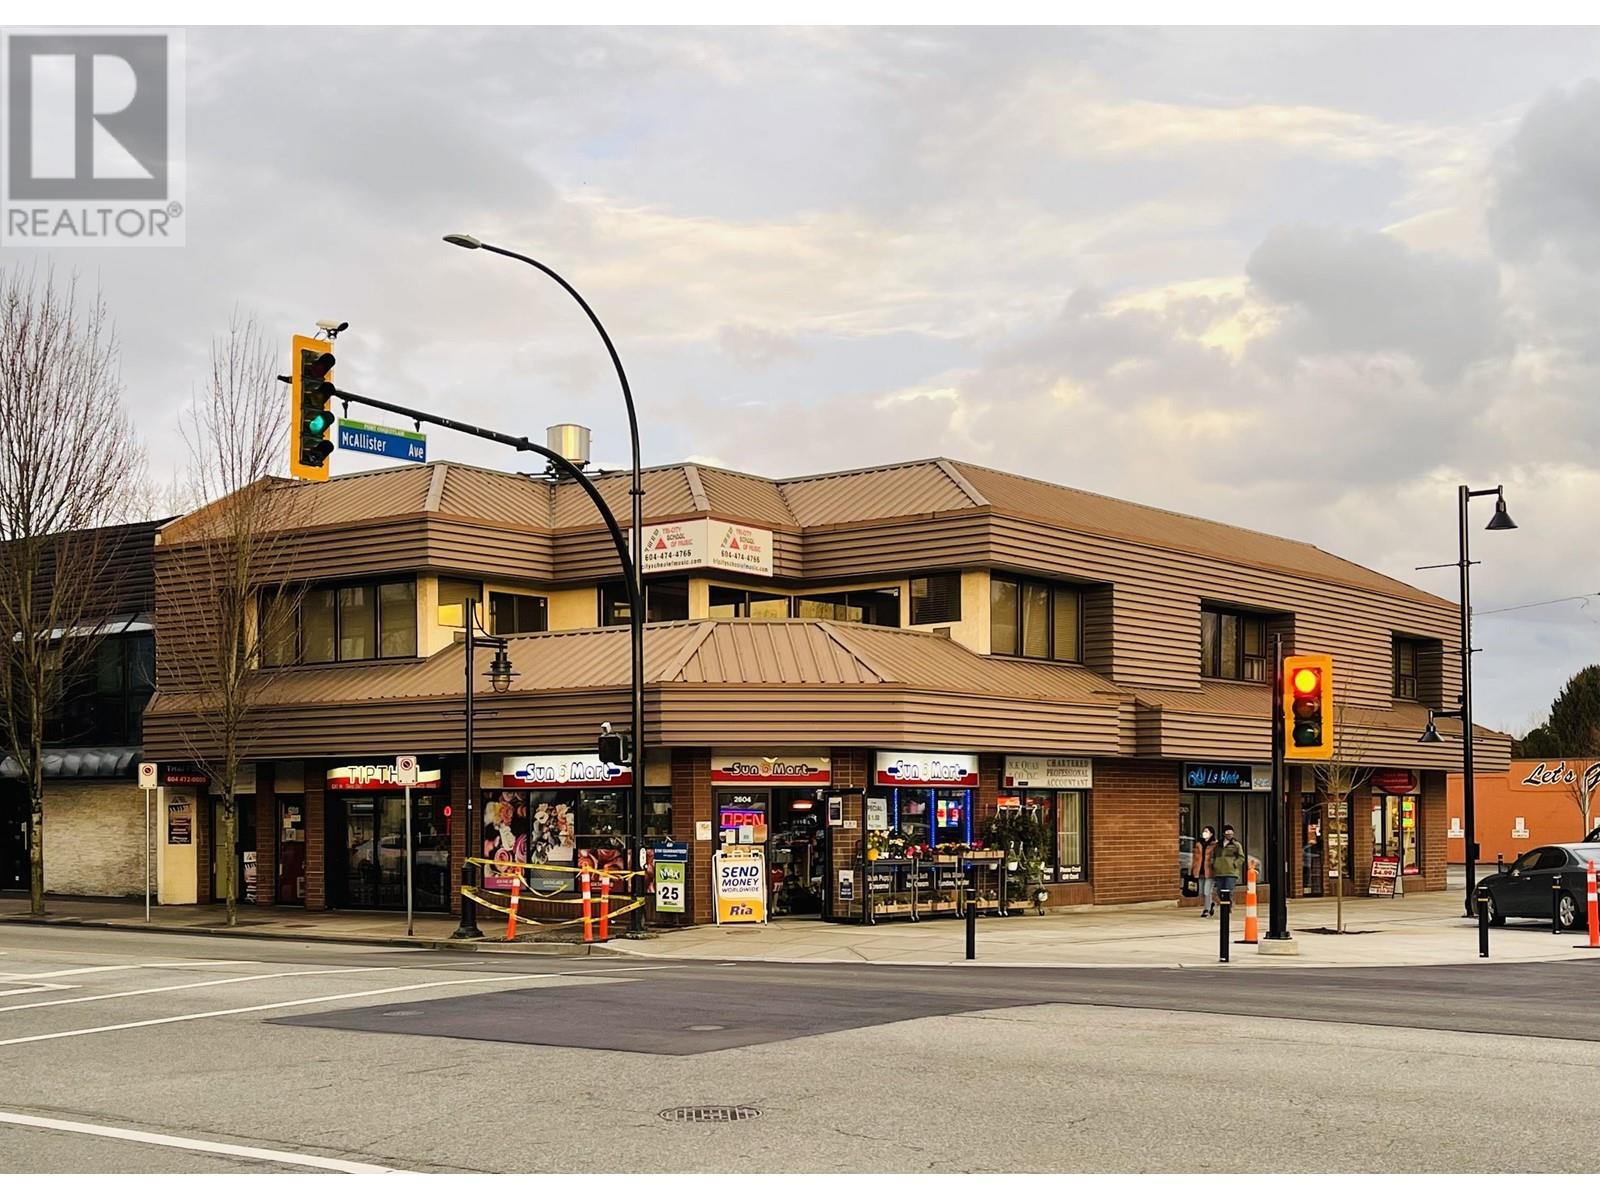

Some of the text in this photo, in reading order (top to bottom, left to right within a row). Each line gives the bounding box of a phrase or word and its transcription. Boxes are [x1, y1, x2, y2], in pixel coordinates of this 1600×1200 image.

[342, 432, 424, 459] McAllister Ave
[732, 762, 809, 775] Sun Mart
[896, 760, 960, 780] Sun Mart
[1046, 759, 1089, 768] CHARTERED
[525, 761, 612, 781] Sun Mart
[1046, 769, 1089, 777] PROFESSIONAL
[1522, 760, 1577, 786] Let's
[1047, 779, 1089, 787] ACCOUNTANT
[721, 812, 764, 827] OPEN
[722, 866, 759, 878] SEND
[721, 878, 759, 887] MONEY
[729, 903, 753, 916] Ria
